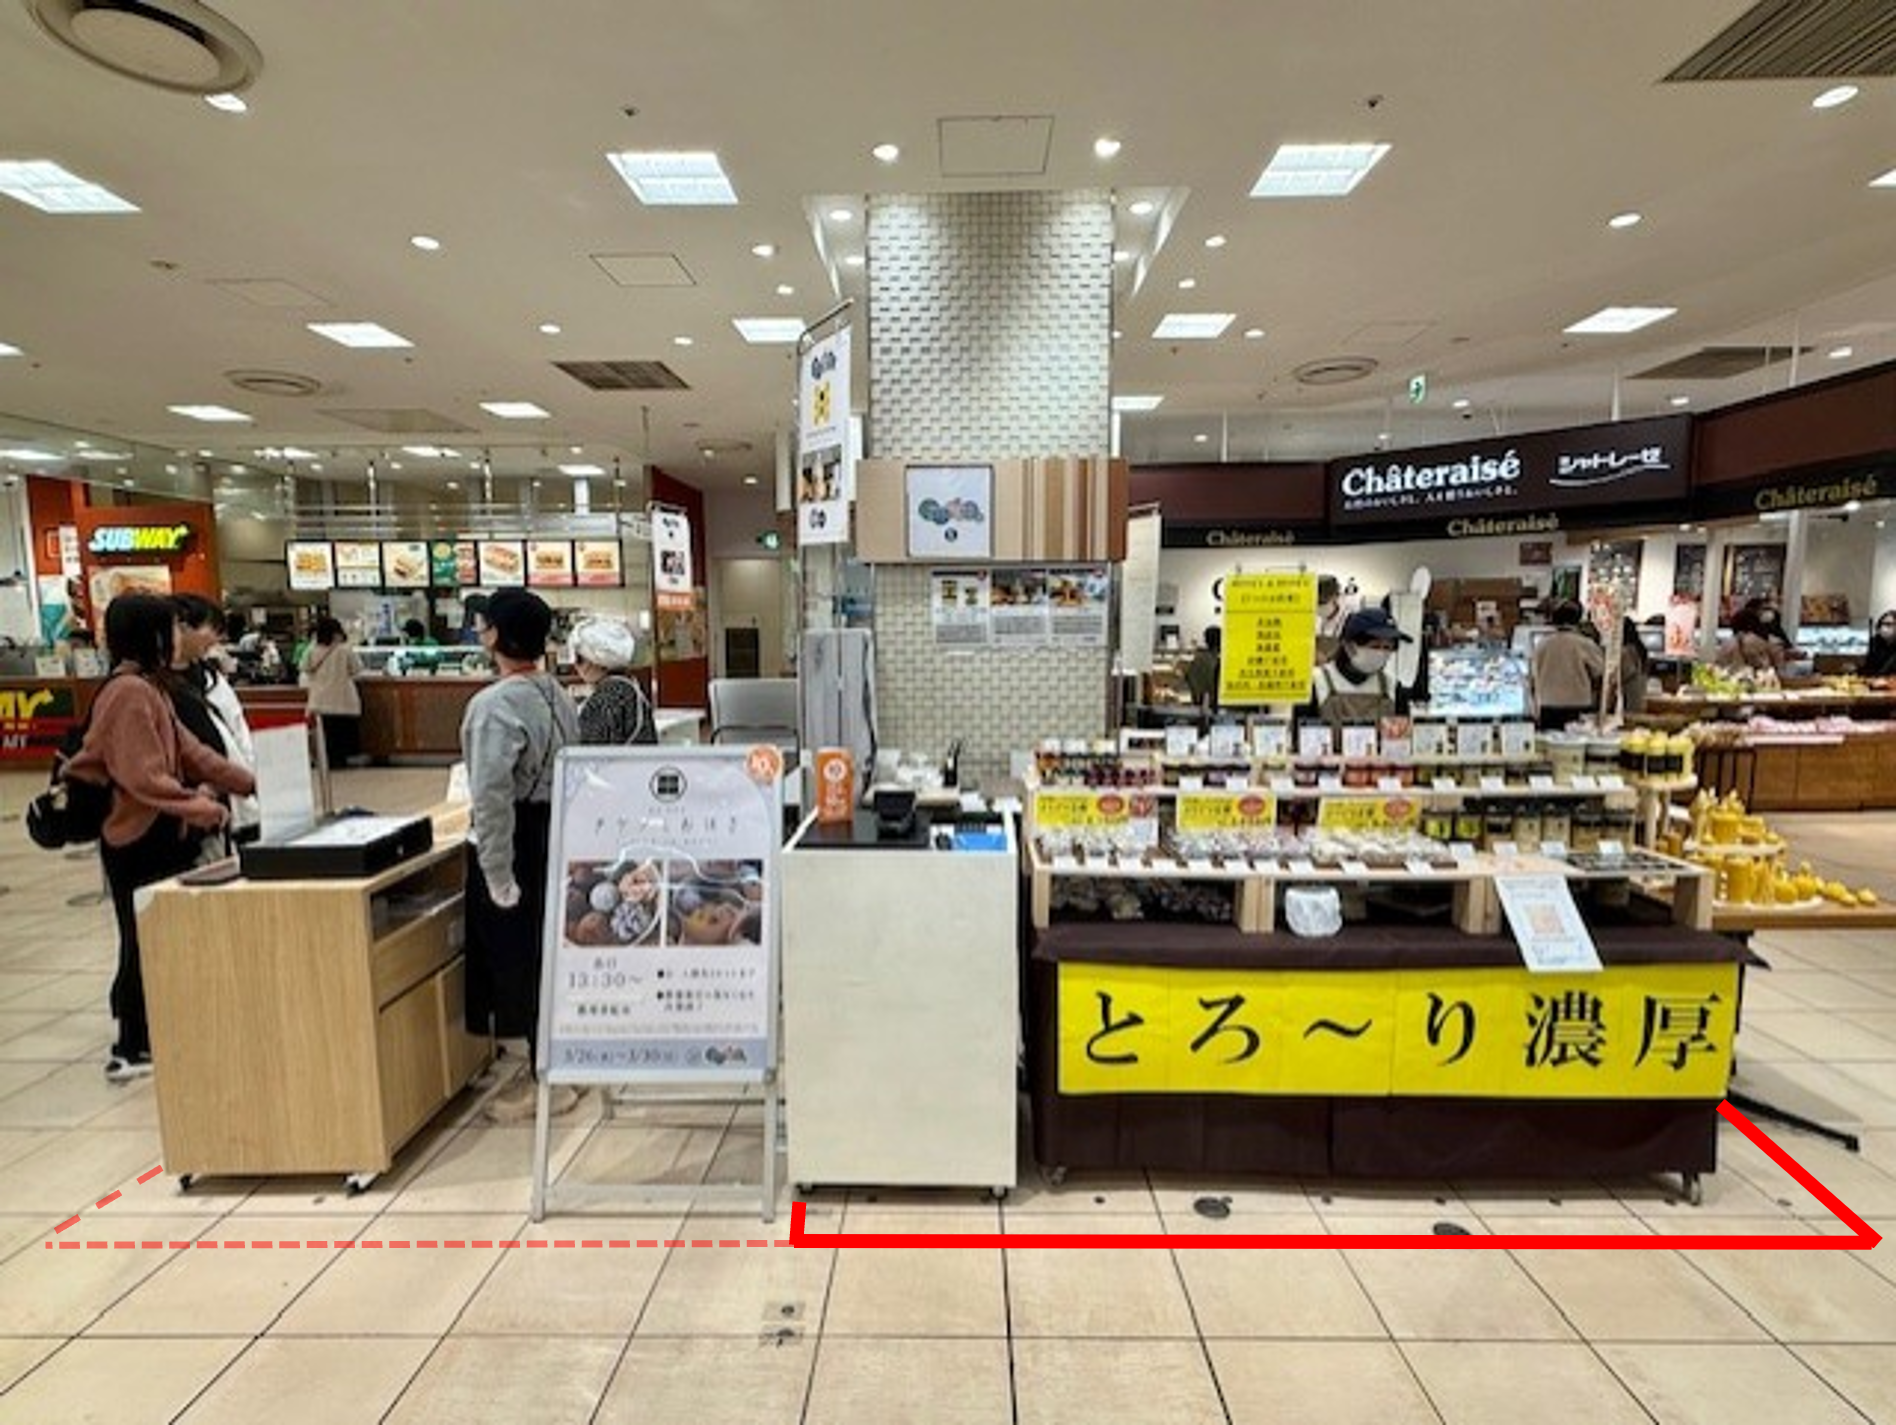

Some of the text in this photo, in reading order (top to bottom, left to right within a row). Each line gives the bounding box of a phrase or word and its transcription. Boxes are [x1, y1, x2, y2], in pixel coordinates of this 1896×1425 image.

[1341, 449, 1521, 497] Châteraisé
[88, 524, 190, 552] SUBWAY
[1084, 990, 1718, 1071] とろ～り濃厚
